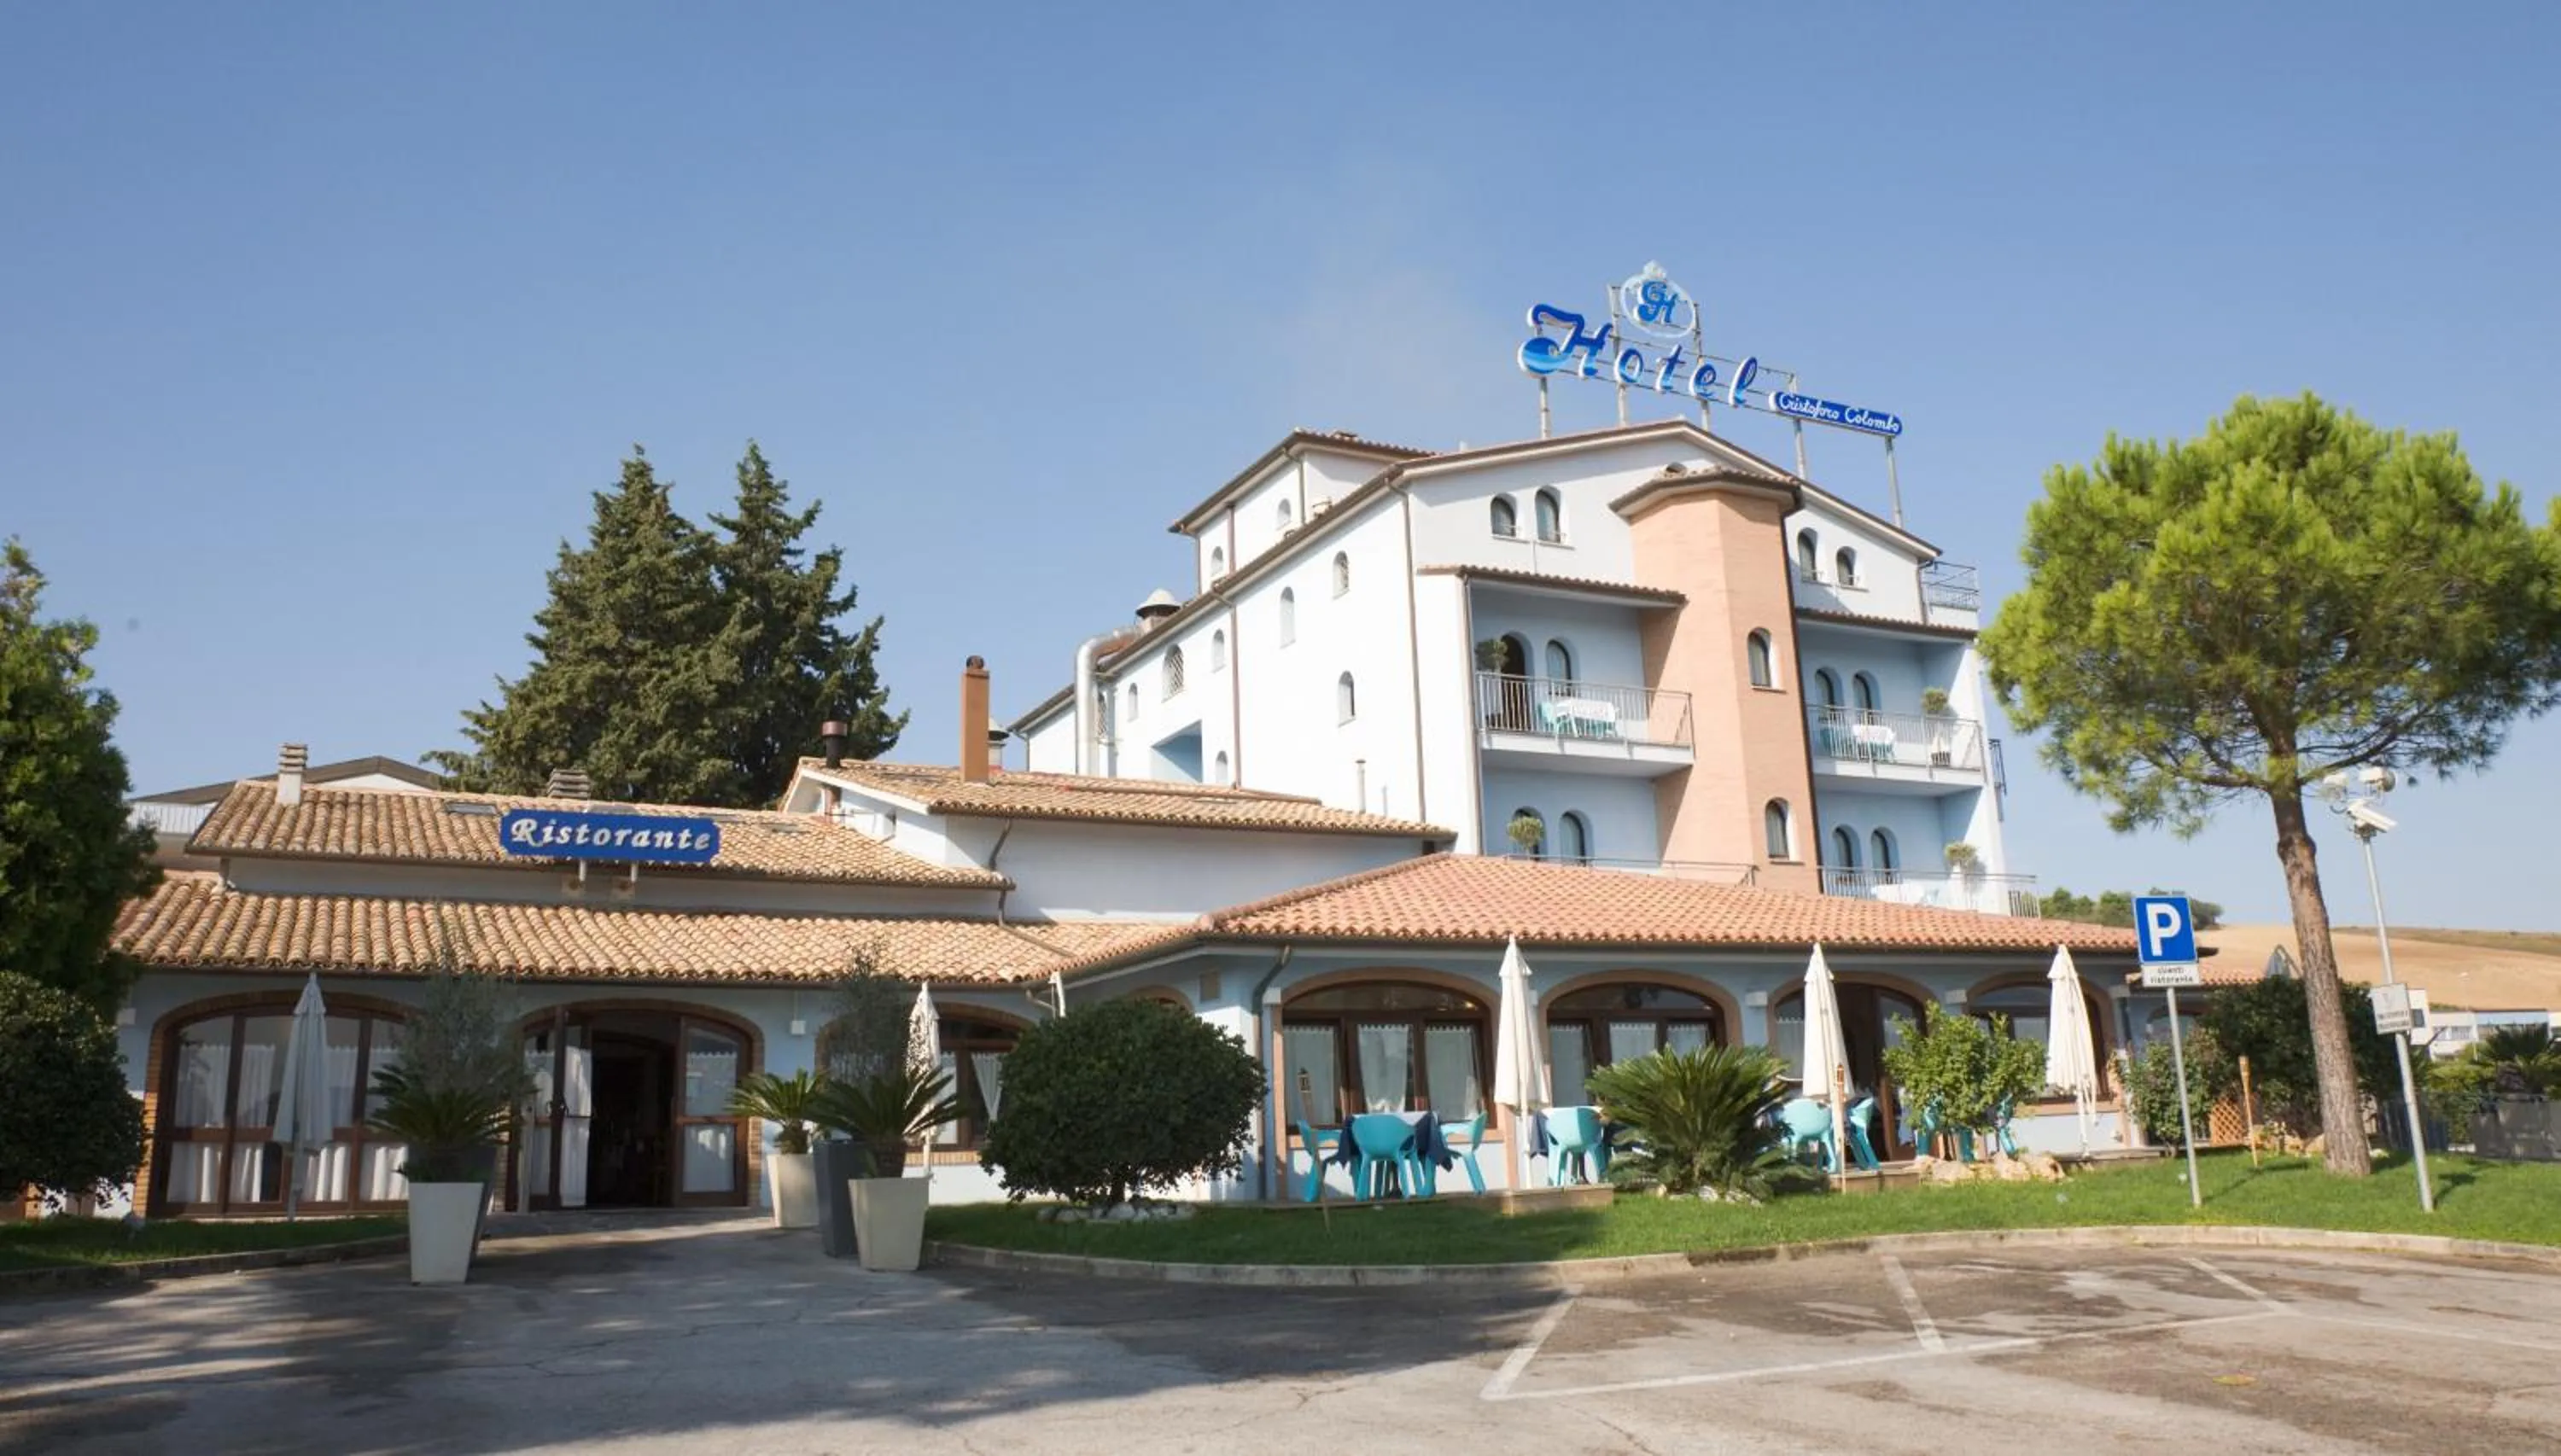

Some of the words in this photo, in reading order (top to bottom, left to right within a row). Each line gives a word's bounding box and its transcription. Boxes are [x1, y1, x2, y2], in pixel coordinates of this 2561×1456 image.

[1518, 304, 1758, 406] Hotel
[1779, 393, 1840, 418] Cristoforo
[1845, 406, 1899, 432] Colombo
[511, 818, 711, 851] Ristorante
[2145, 902, 2182, 957] P
